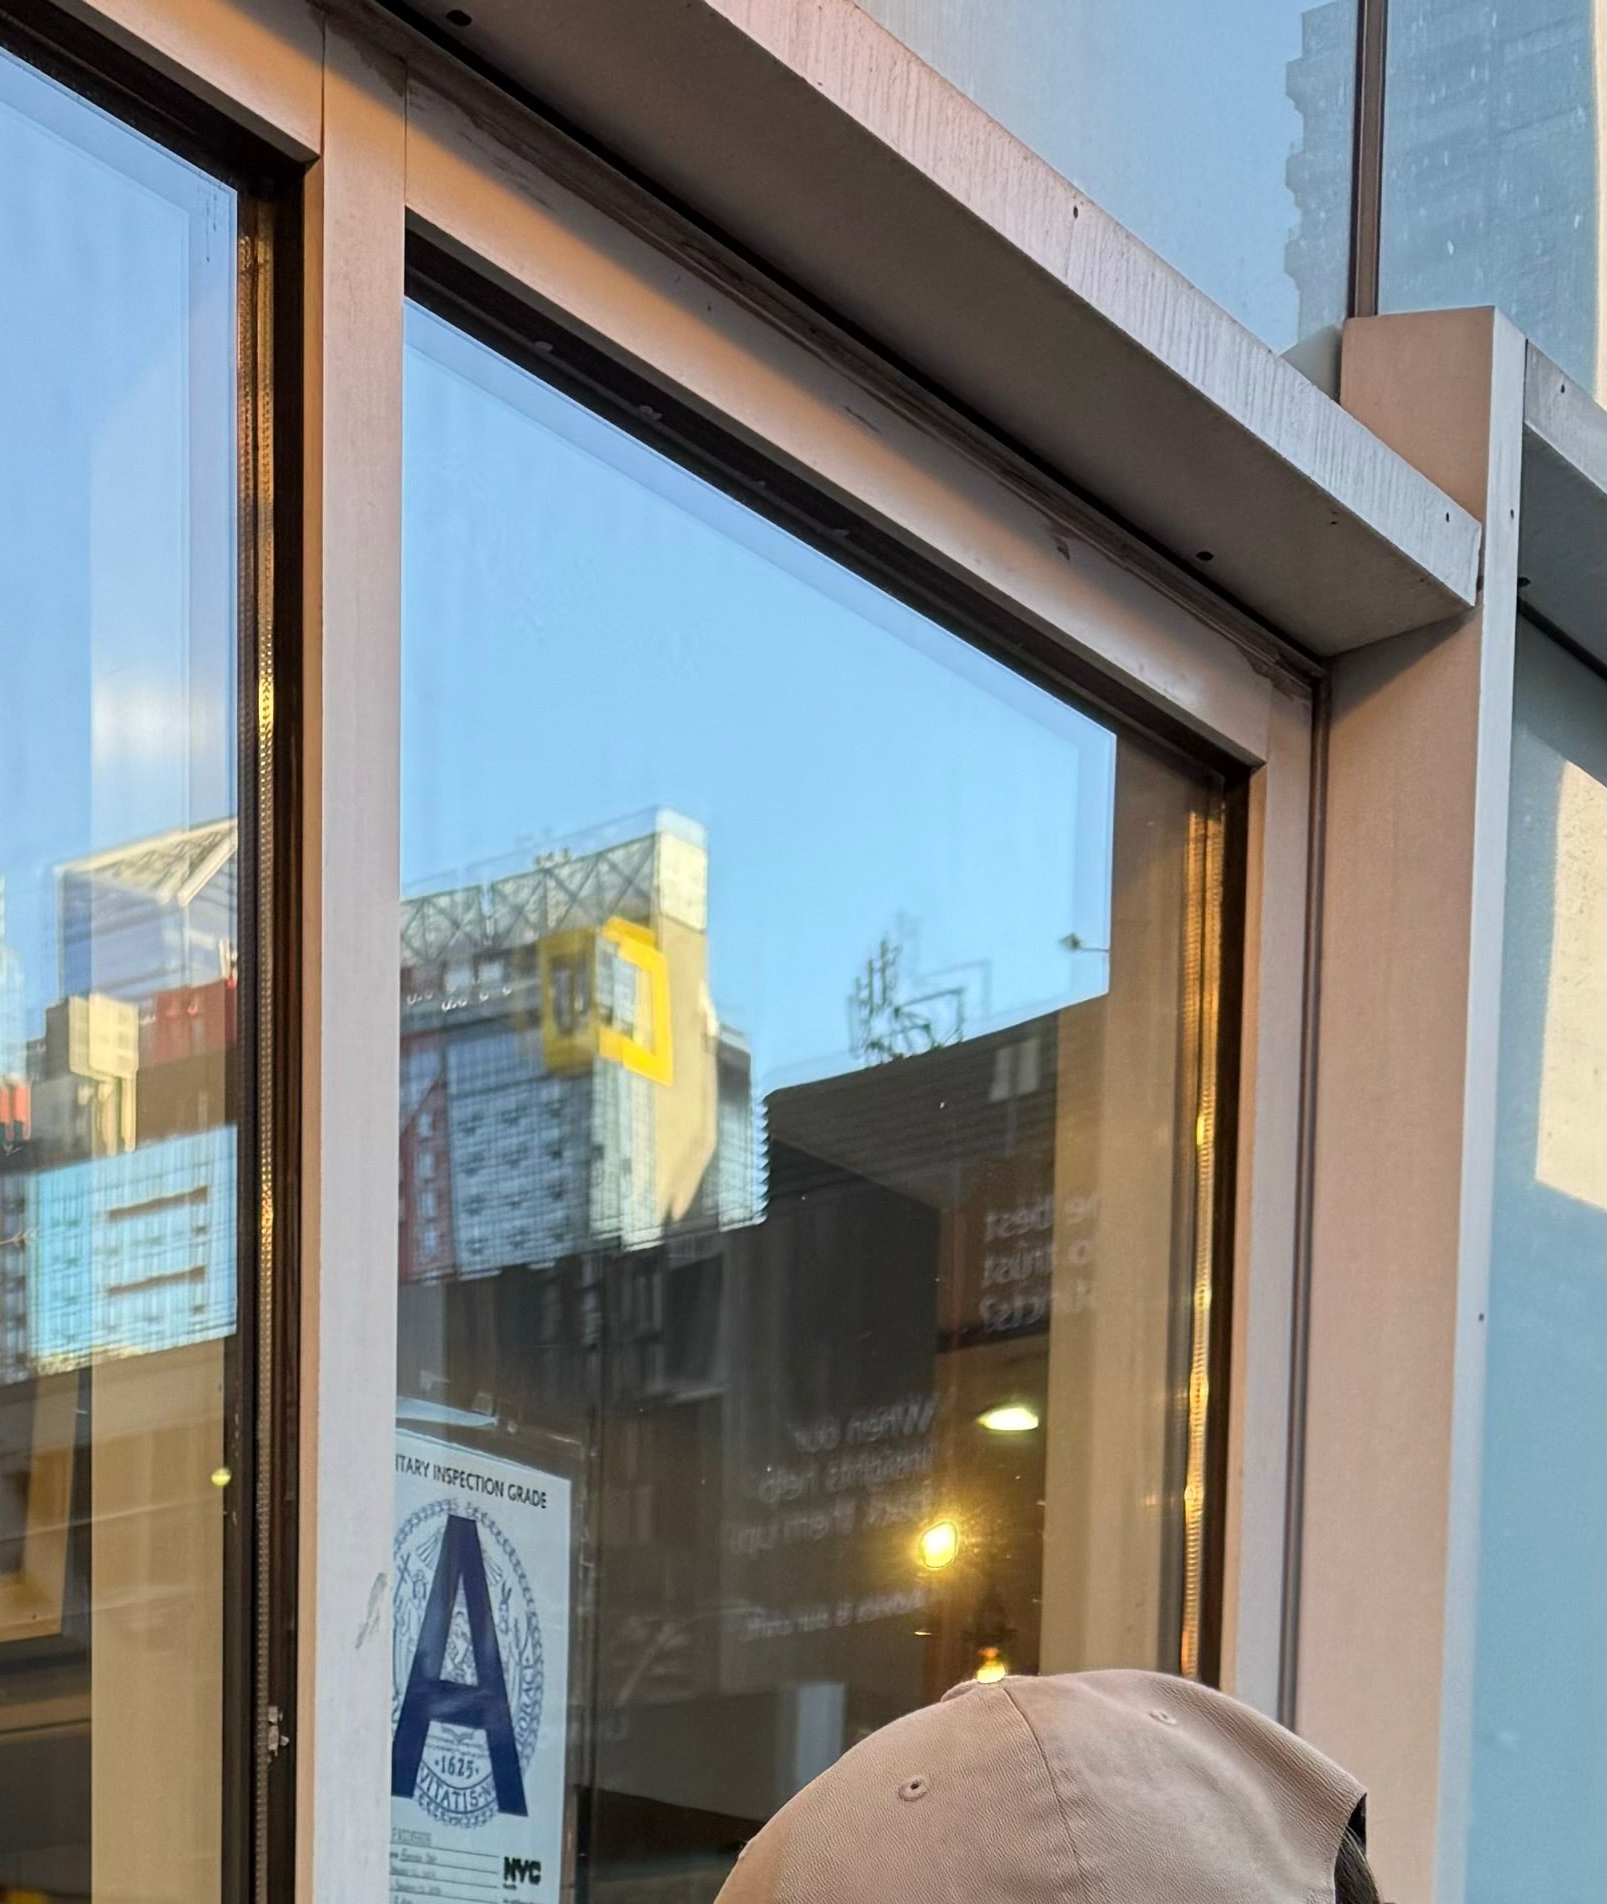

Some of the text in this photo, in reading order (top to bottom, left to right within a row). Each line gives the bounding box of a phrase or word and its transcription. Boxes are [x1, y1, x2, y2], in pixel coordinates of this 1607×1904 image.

[433, 1464, 504, 1498] INSPECTION
[508, 1483, 547, 1509] GRADE
[391, 1514, 529, 1817] A
[441, 1755, 474, 1779] 1625
[504, 1856, 542, 1886] NYC
